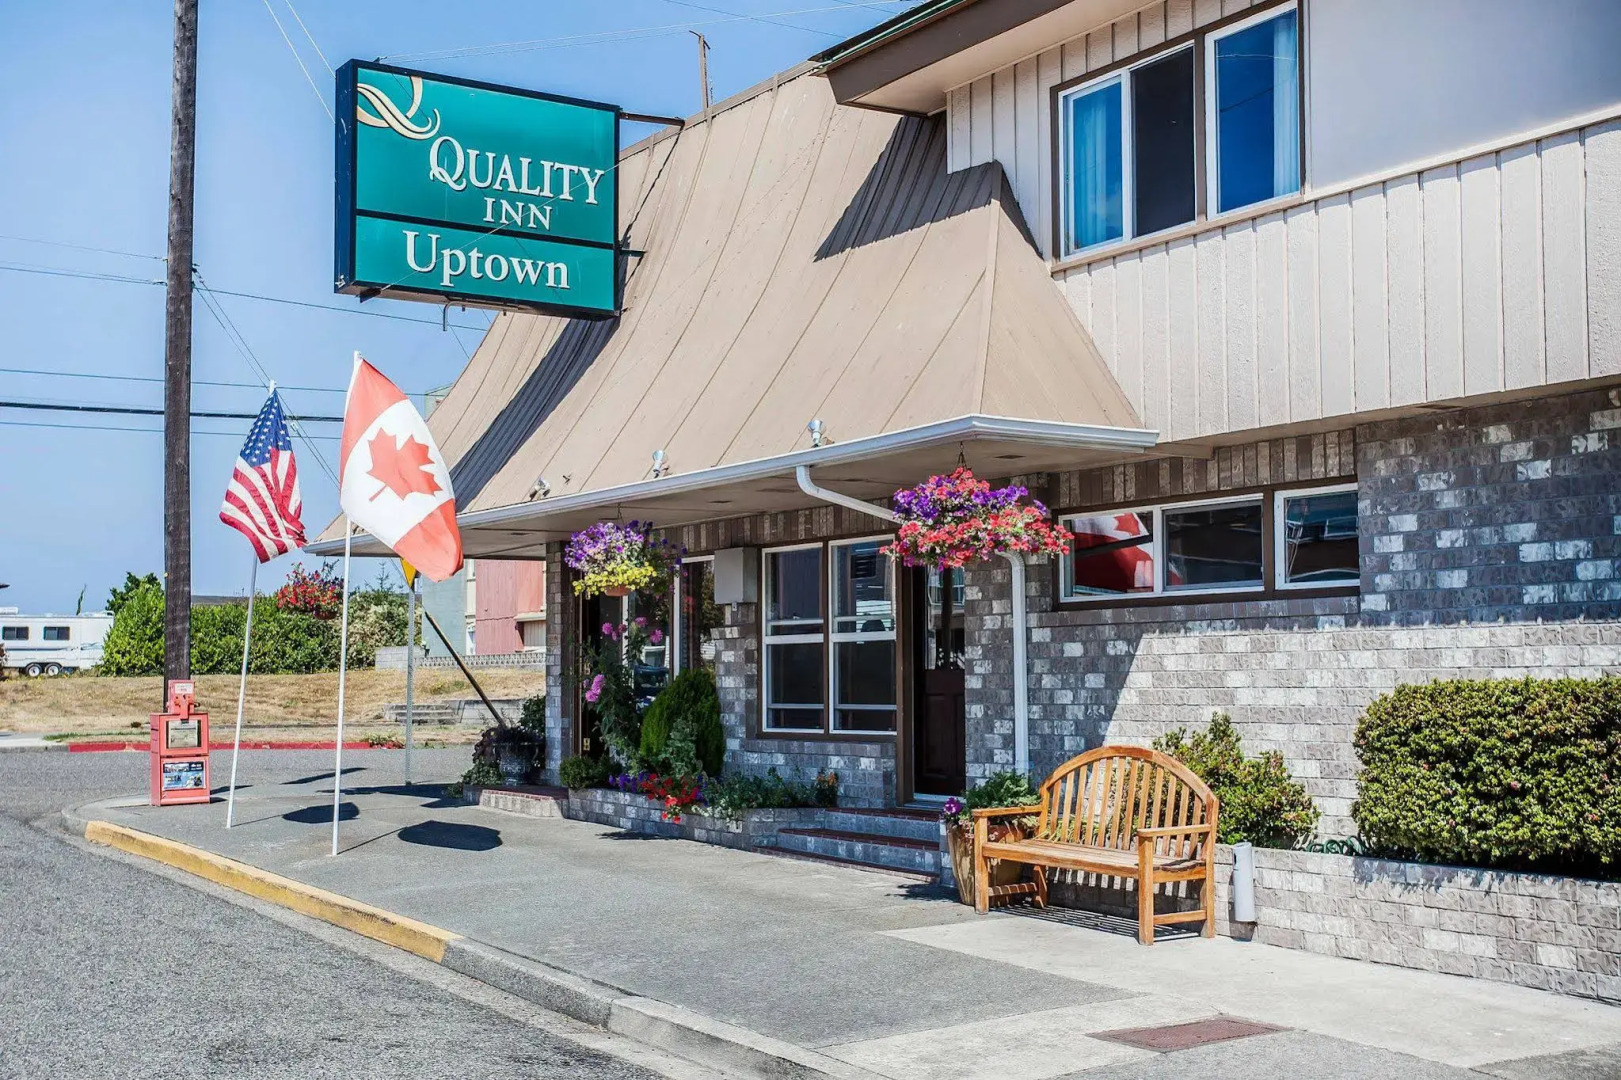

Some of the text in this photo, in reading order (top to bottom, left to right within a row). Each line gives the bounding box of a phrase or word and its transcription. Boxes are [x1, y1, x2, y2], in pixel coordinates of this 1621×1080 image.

[430, 136, 604, 204] QUALITY
[484, 197, 552, 230] INN
[403, 230, 570, 289] Uptown
